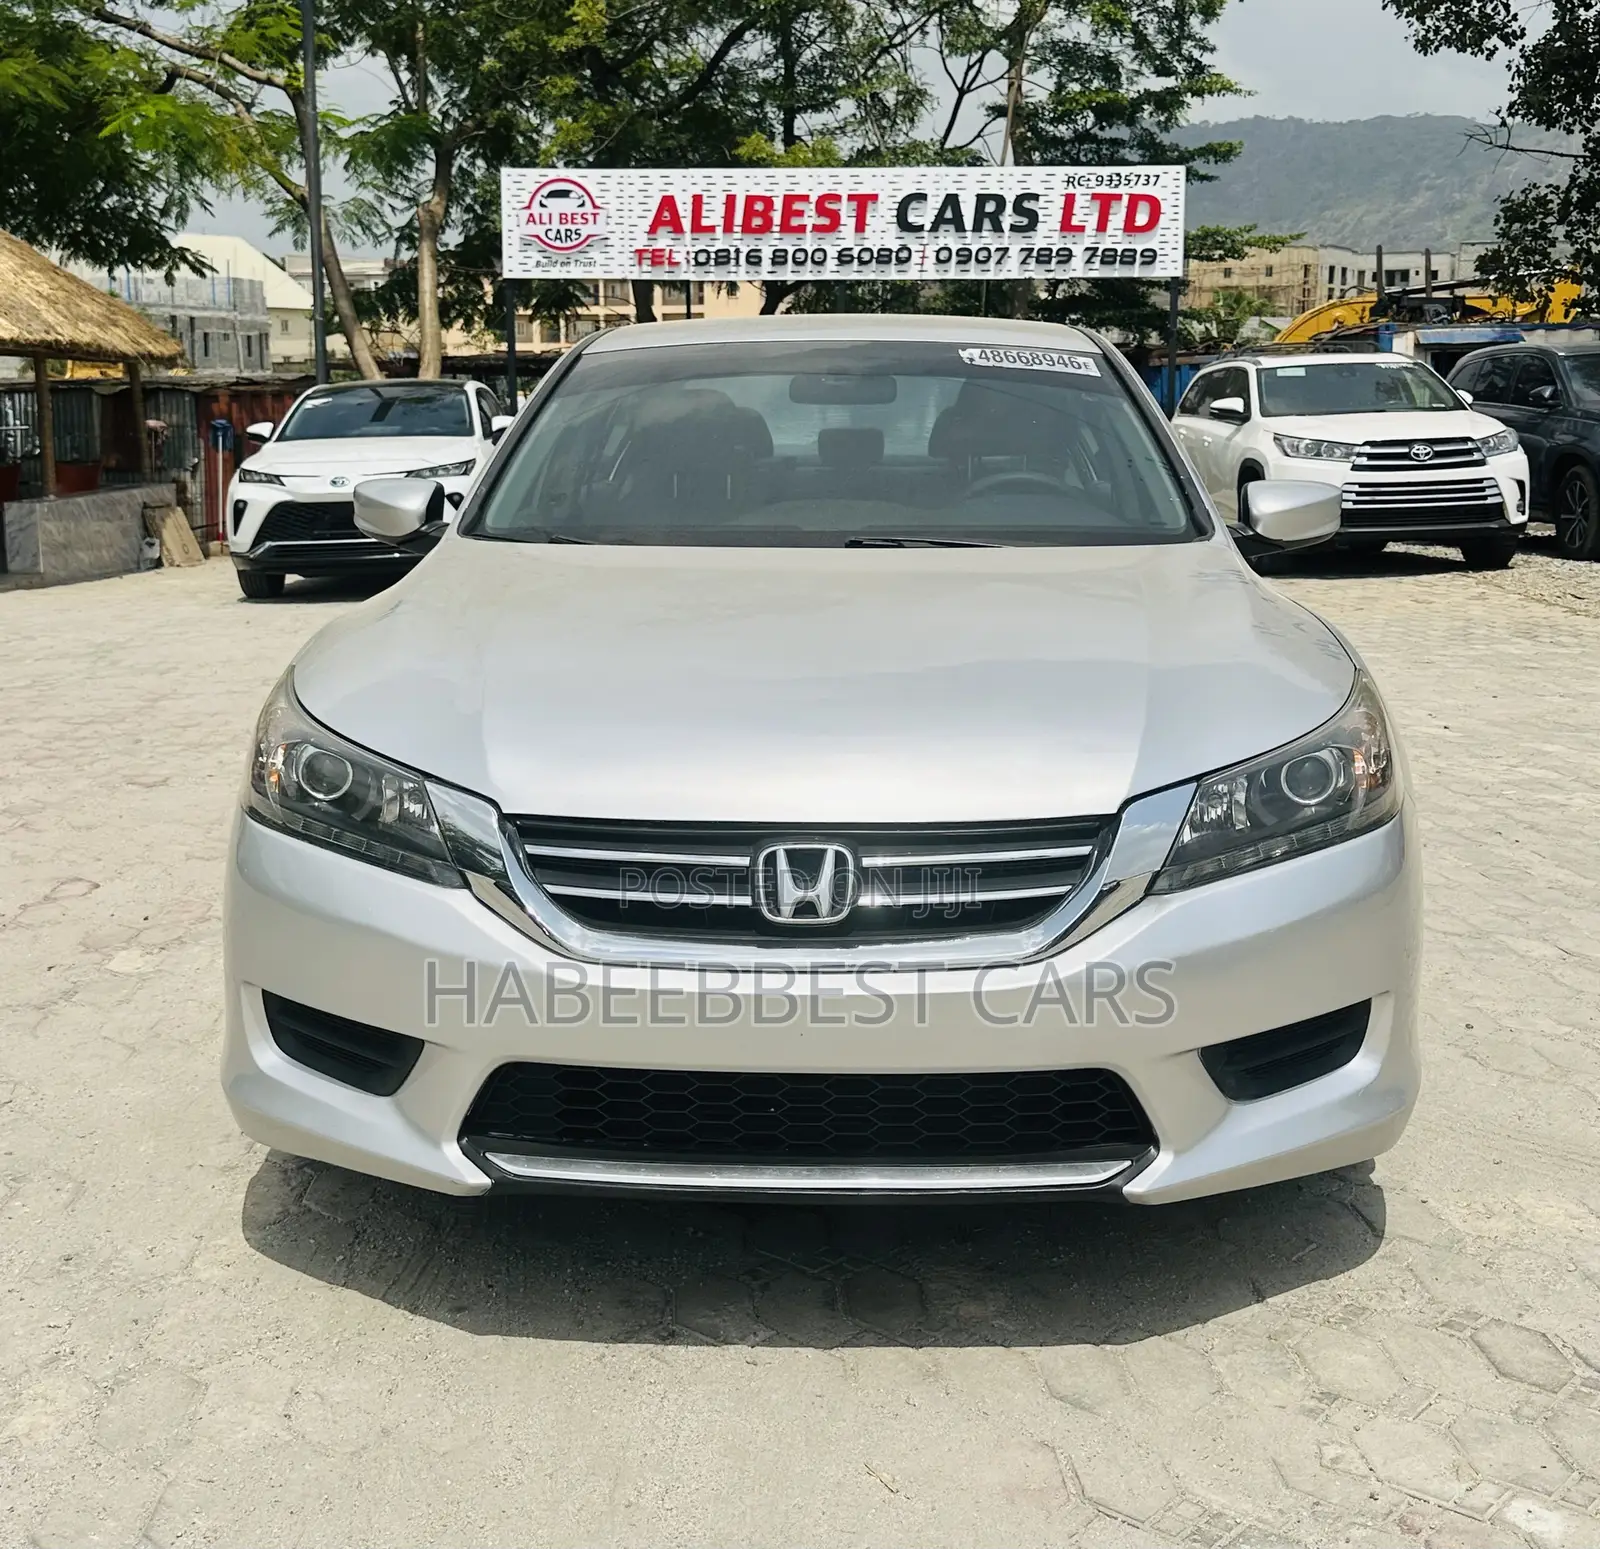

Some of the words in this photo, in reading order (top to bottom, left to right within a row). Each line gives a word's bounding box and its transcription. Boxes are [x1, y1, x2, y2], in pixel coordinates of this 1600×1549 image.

[1095, 174, 1160, 187] 9335737
[526, 212, 552, 225] ALI
[559, 212, 600, 225] BEST
[648, 193, 879, 235] ALIBEST
[896, 192, 1040, 233] CARS
[1059, 192, 1162, 233] LTD
[544, 228, 582, 244] CARS
[535, 259, 558, 268] Build
[559, 260, 572, 268] on
[574, 259, 597, 268] Trust
[694, 248, 763, 267] 0816
[771, 248, 827, 266] 800
[837, 246, 912, 265] 6080
[935, 246, 1010, 265] 0907
[1019, 247, 1073, 265] 789
[1084, 246, 1158, 265] 7889
